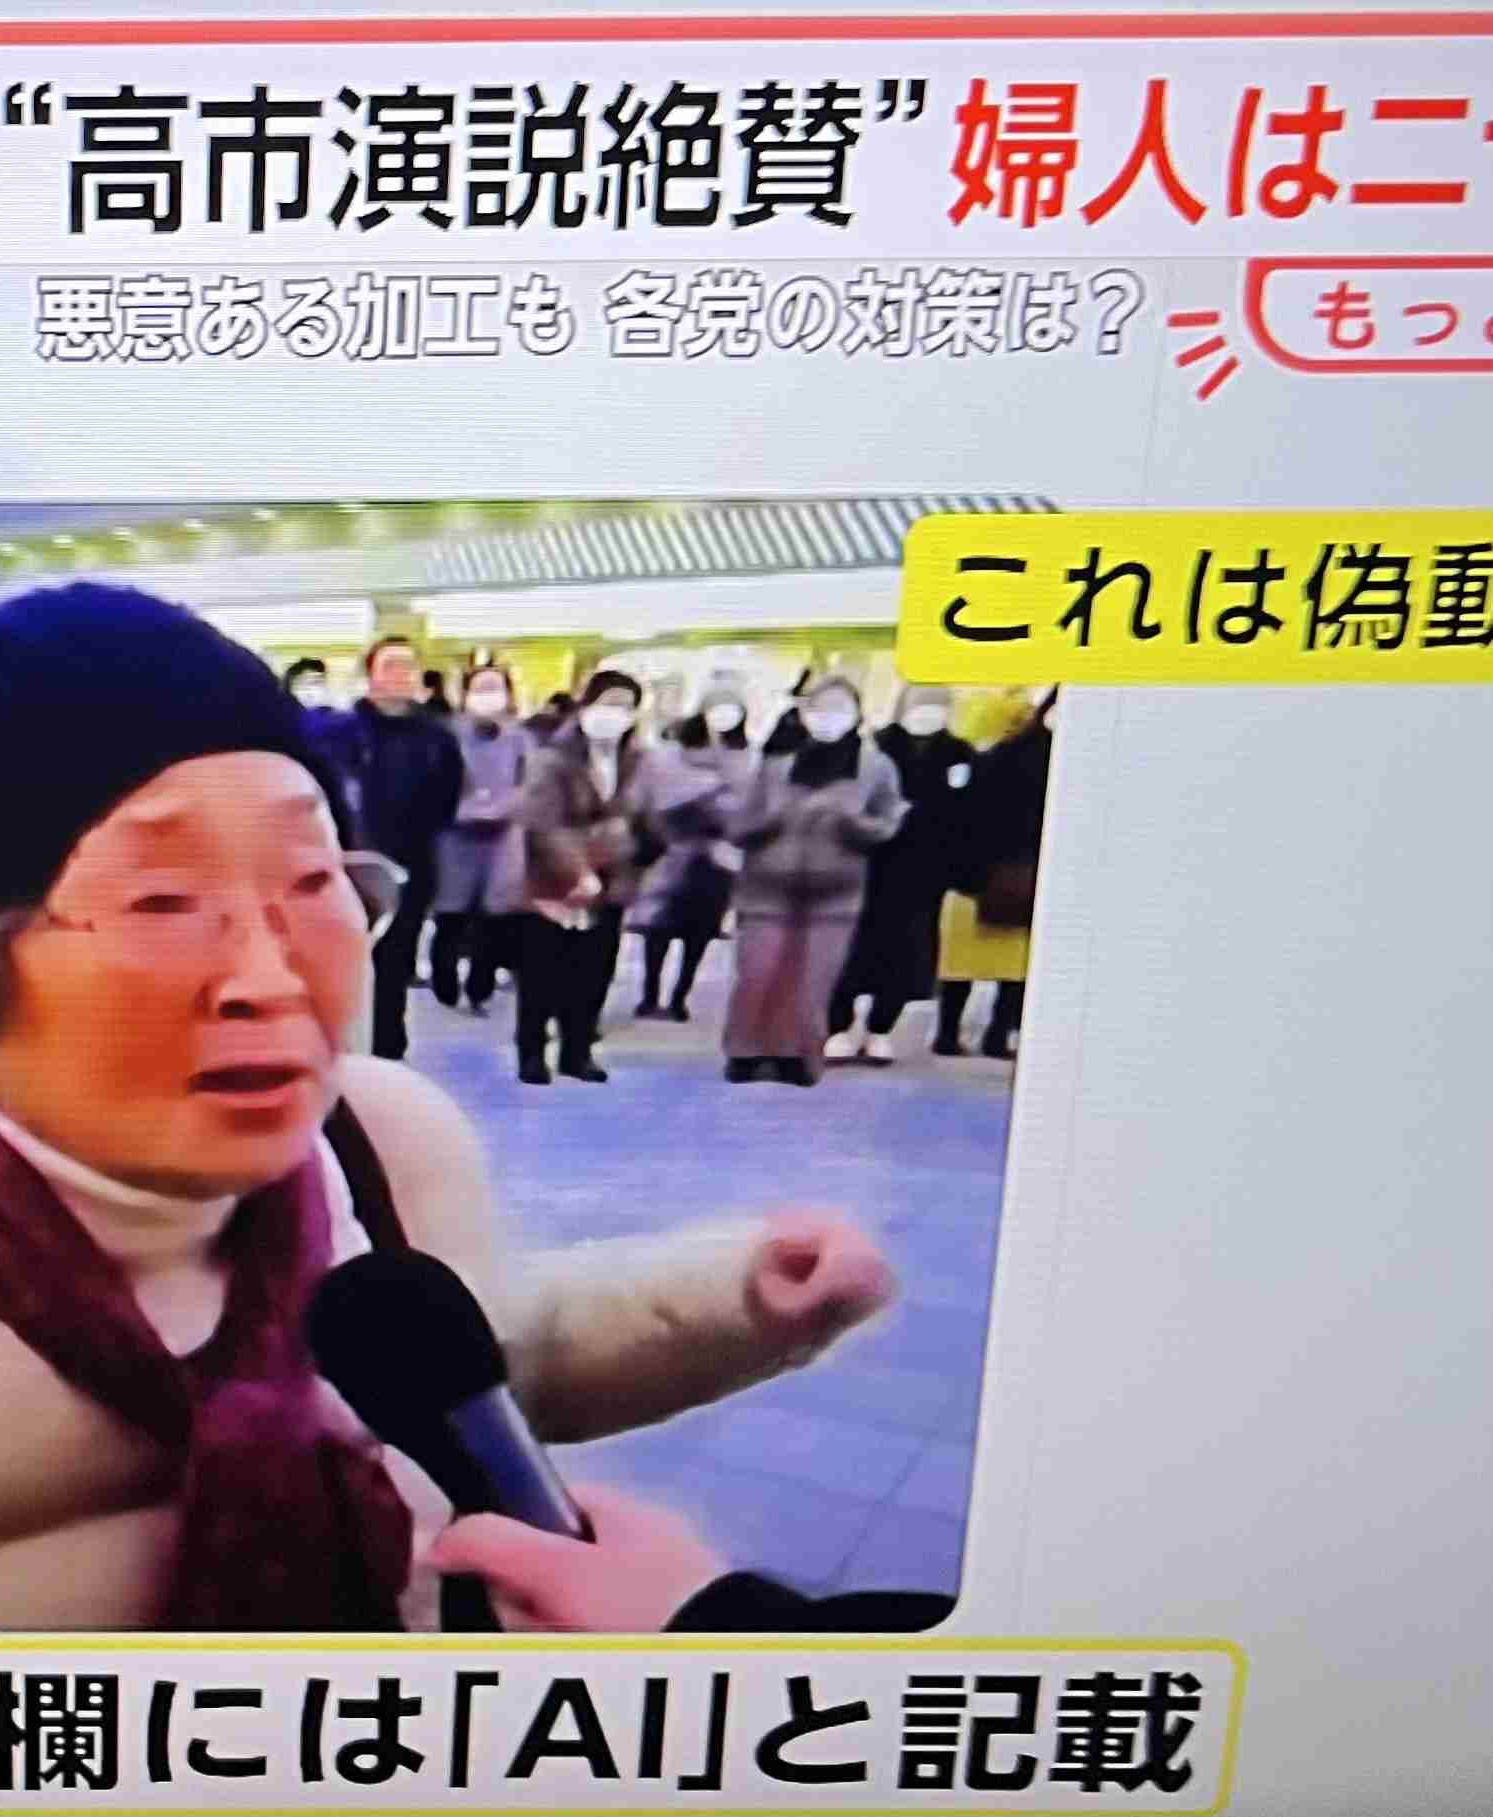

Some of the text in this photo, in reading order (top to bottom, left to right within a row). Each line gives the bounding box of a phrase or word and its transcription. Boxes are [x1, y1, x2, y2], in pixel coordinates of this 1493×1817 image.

[37, 267, 1145, 362] 悪意ある加工も 各党の対策は？
[1314, 281, 1493, 349] もっ
